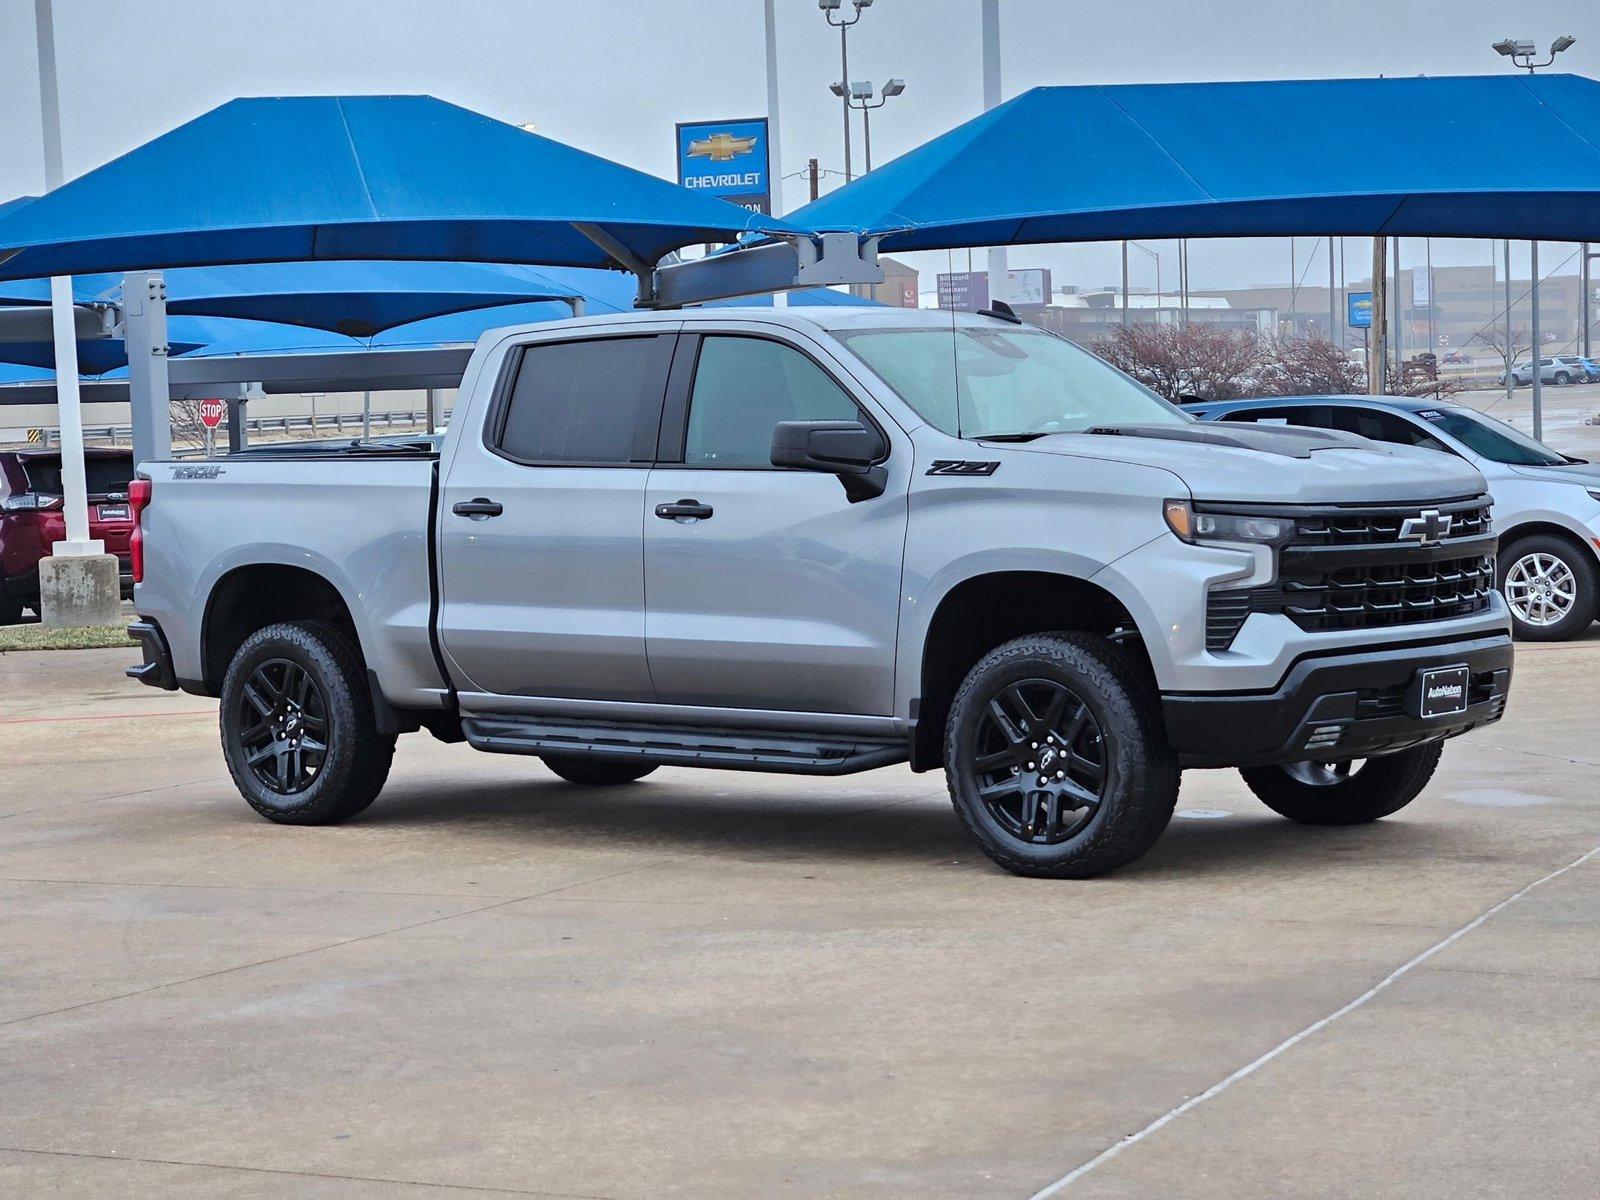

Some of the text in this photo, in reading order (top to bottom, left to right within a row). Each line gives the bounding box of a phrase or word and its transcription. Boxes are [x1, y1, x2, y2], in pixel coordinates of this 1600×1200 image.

[684, 172, 760, 188] CHEVROLET
[202, 404, 221, 417] STOP
[1427, 684, 1462, 698] AutoNation
